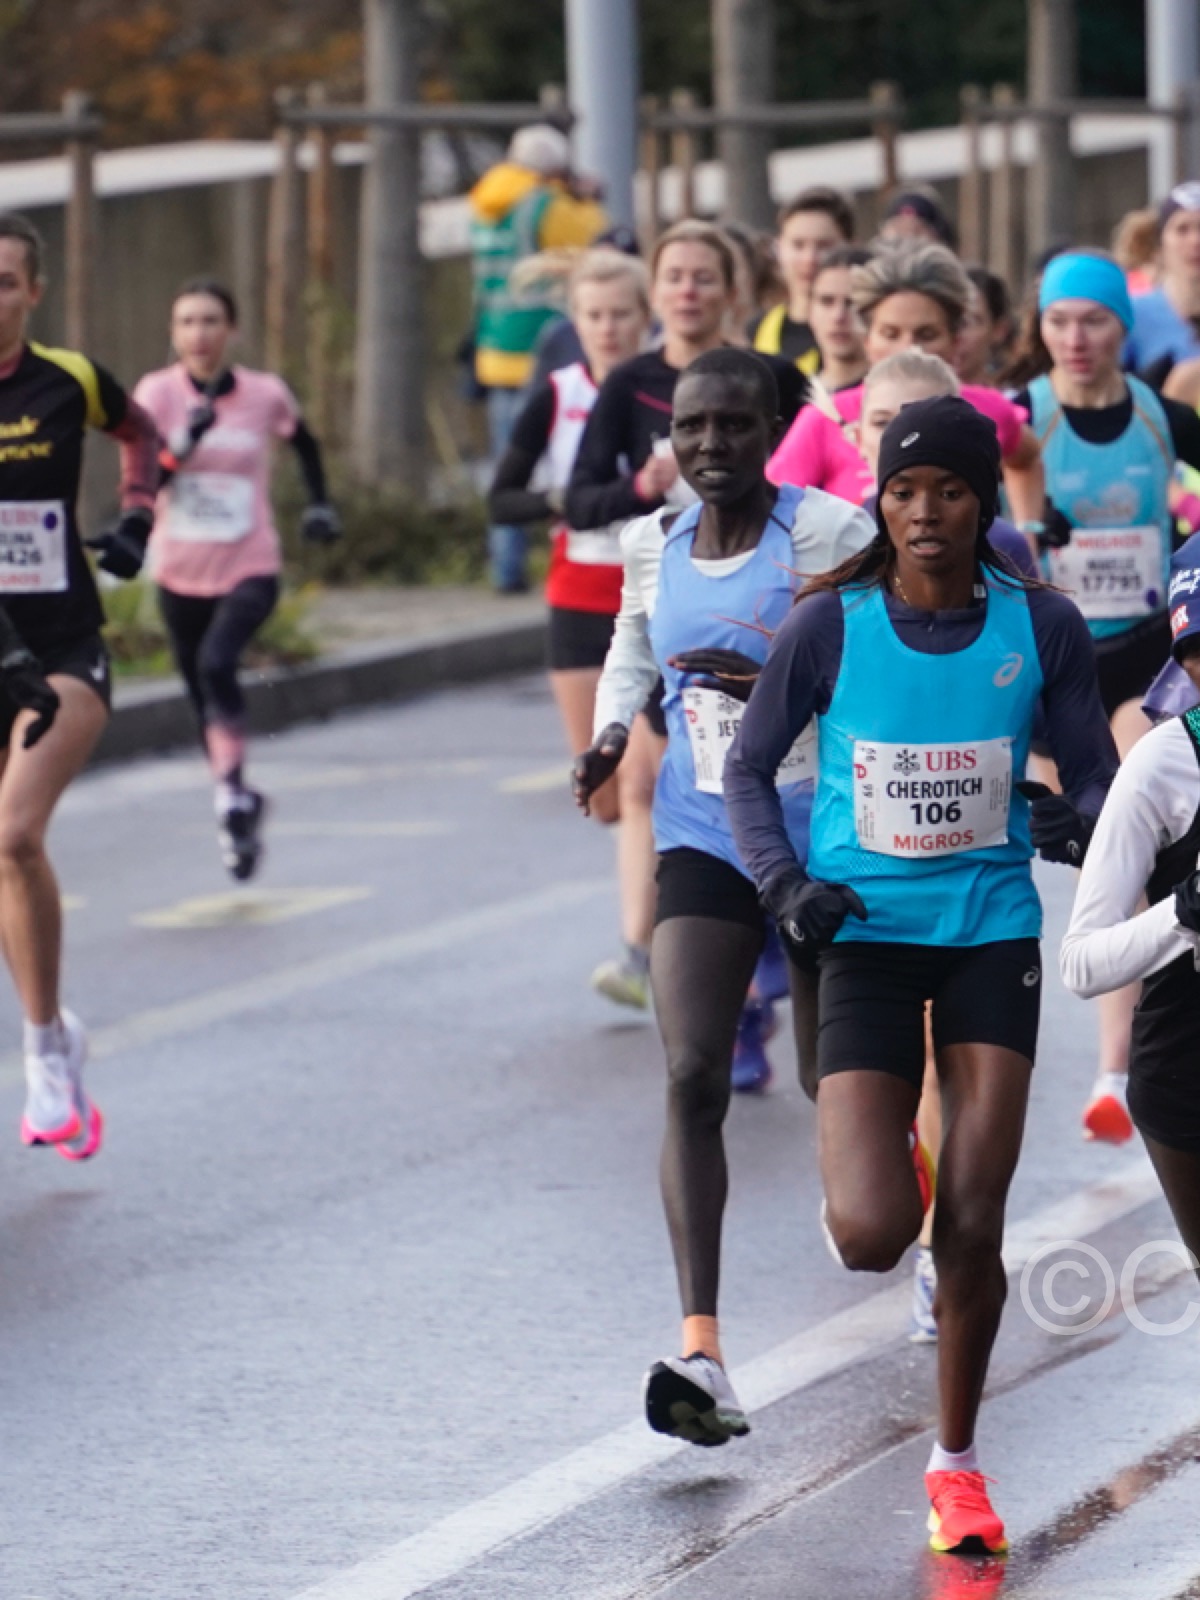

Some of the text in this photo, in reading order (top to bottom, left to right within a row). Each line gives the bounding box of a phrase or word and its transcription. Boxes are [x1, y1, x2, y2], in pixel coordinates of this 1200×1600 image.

[925, 749, 977, 772] UBS
[885, 777, 983, 799] CHEROTICH
[910, 800, 963, 825] 106
[893, 829, 976, 851] MIGROS
